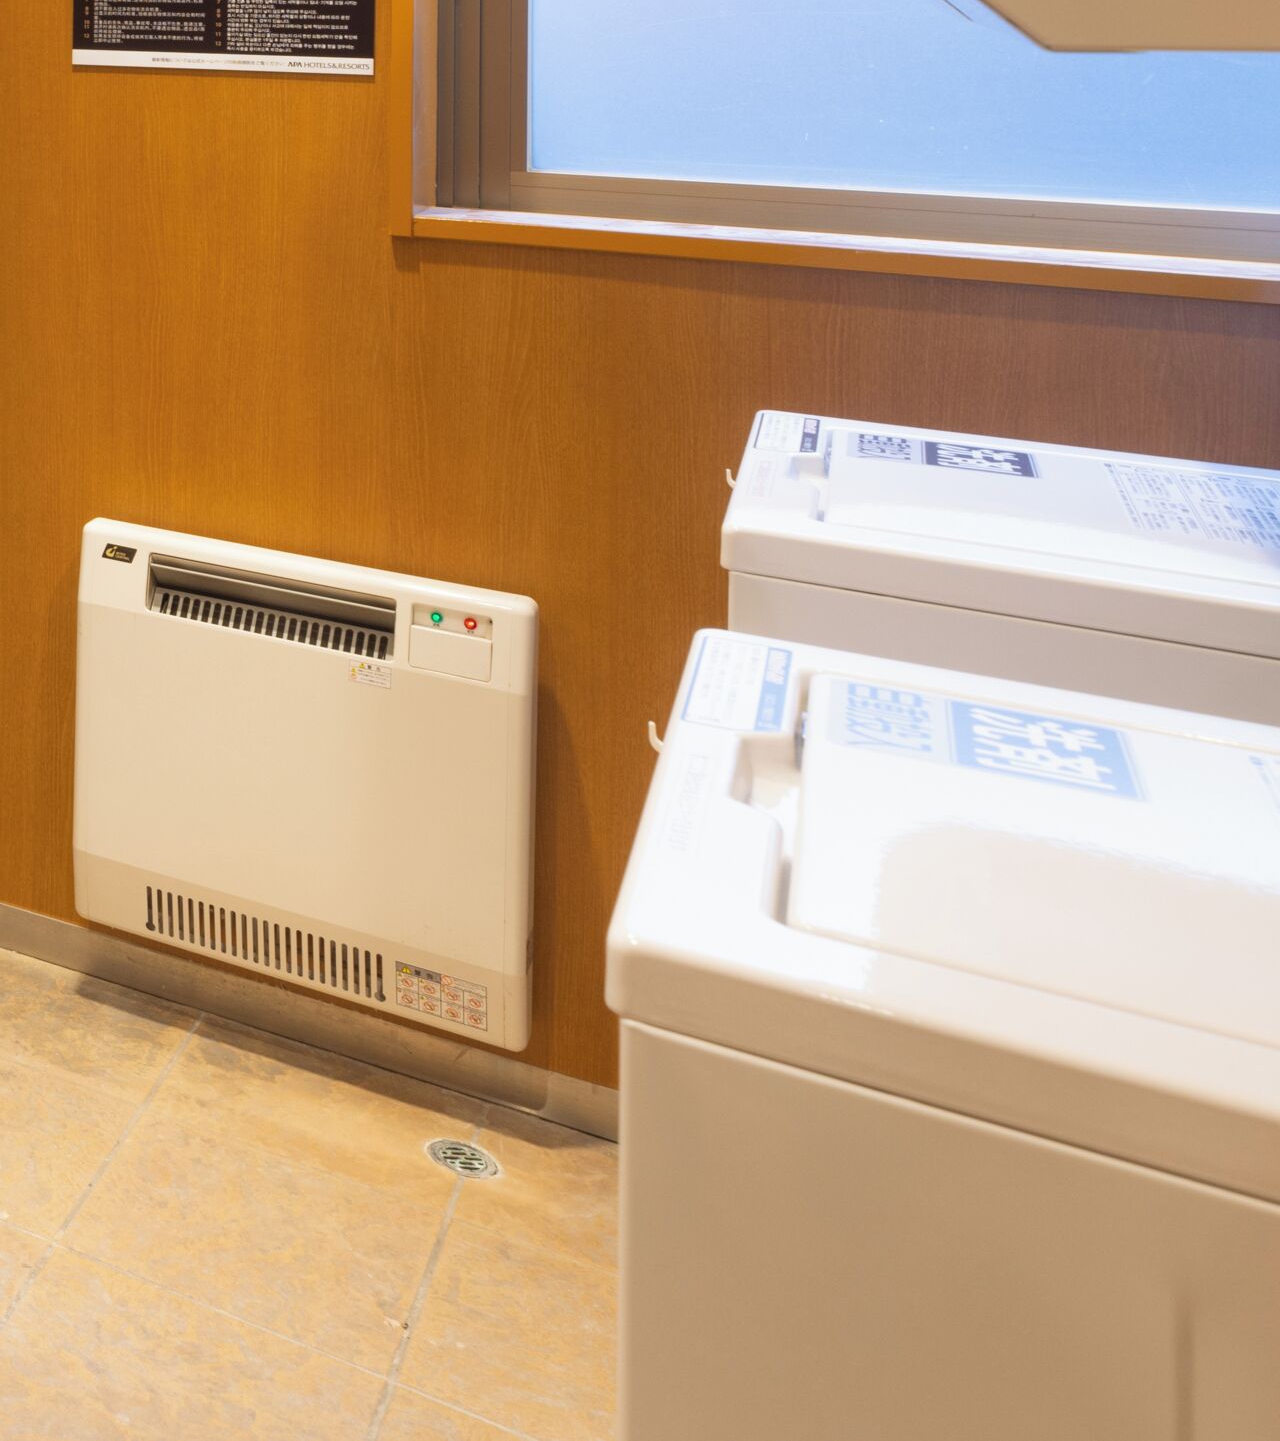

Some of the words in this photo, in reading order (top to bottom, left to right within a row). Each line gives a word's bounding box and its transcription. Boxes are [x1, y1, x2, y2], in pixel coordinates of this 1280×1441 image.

[845, 681, 936, 753] 自動投入
[970, 707, 1118, 792] 洗剤
